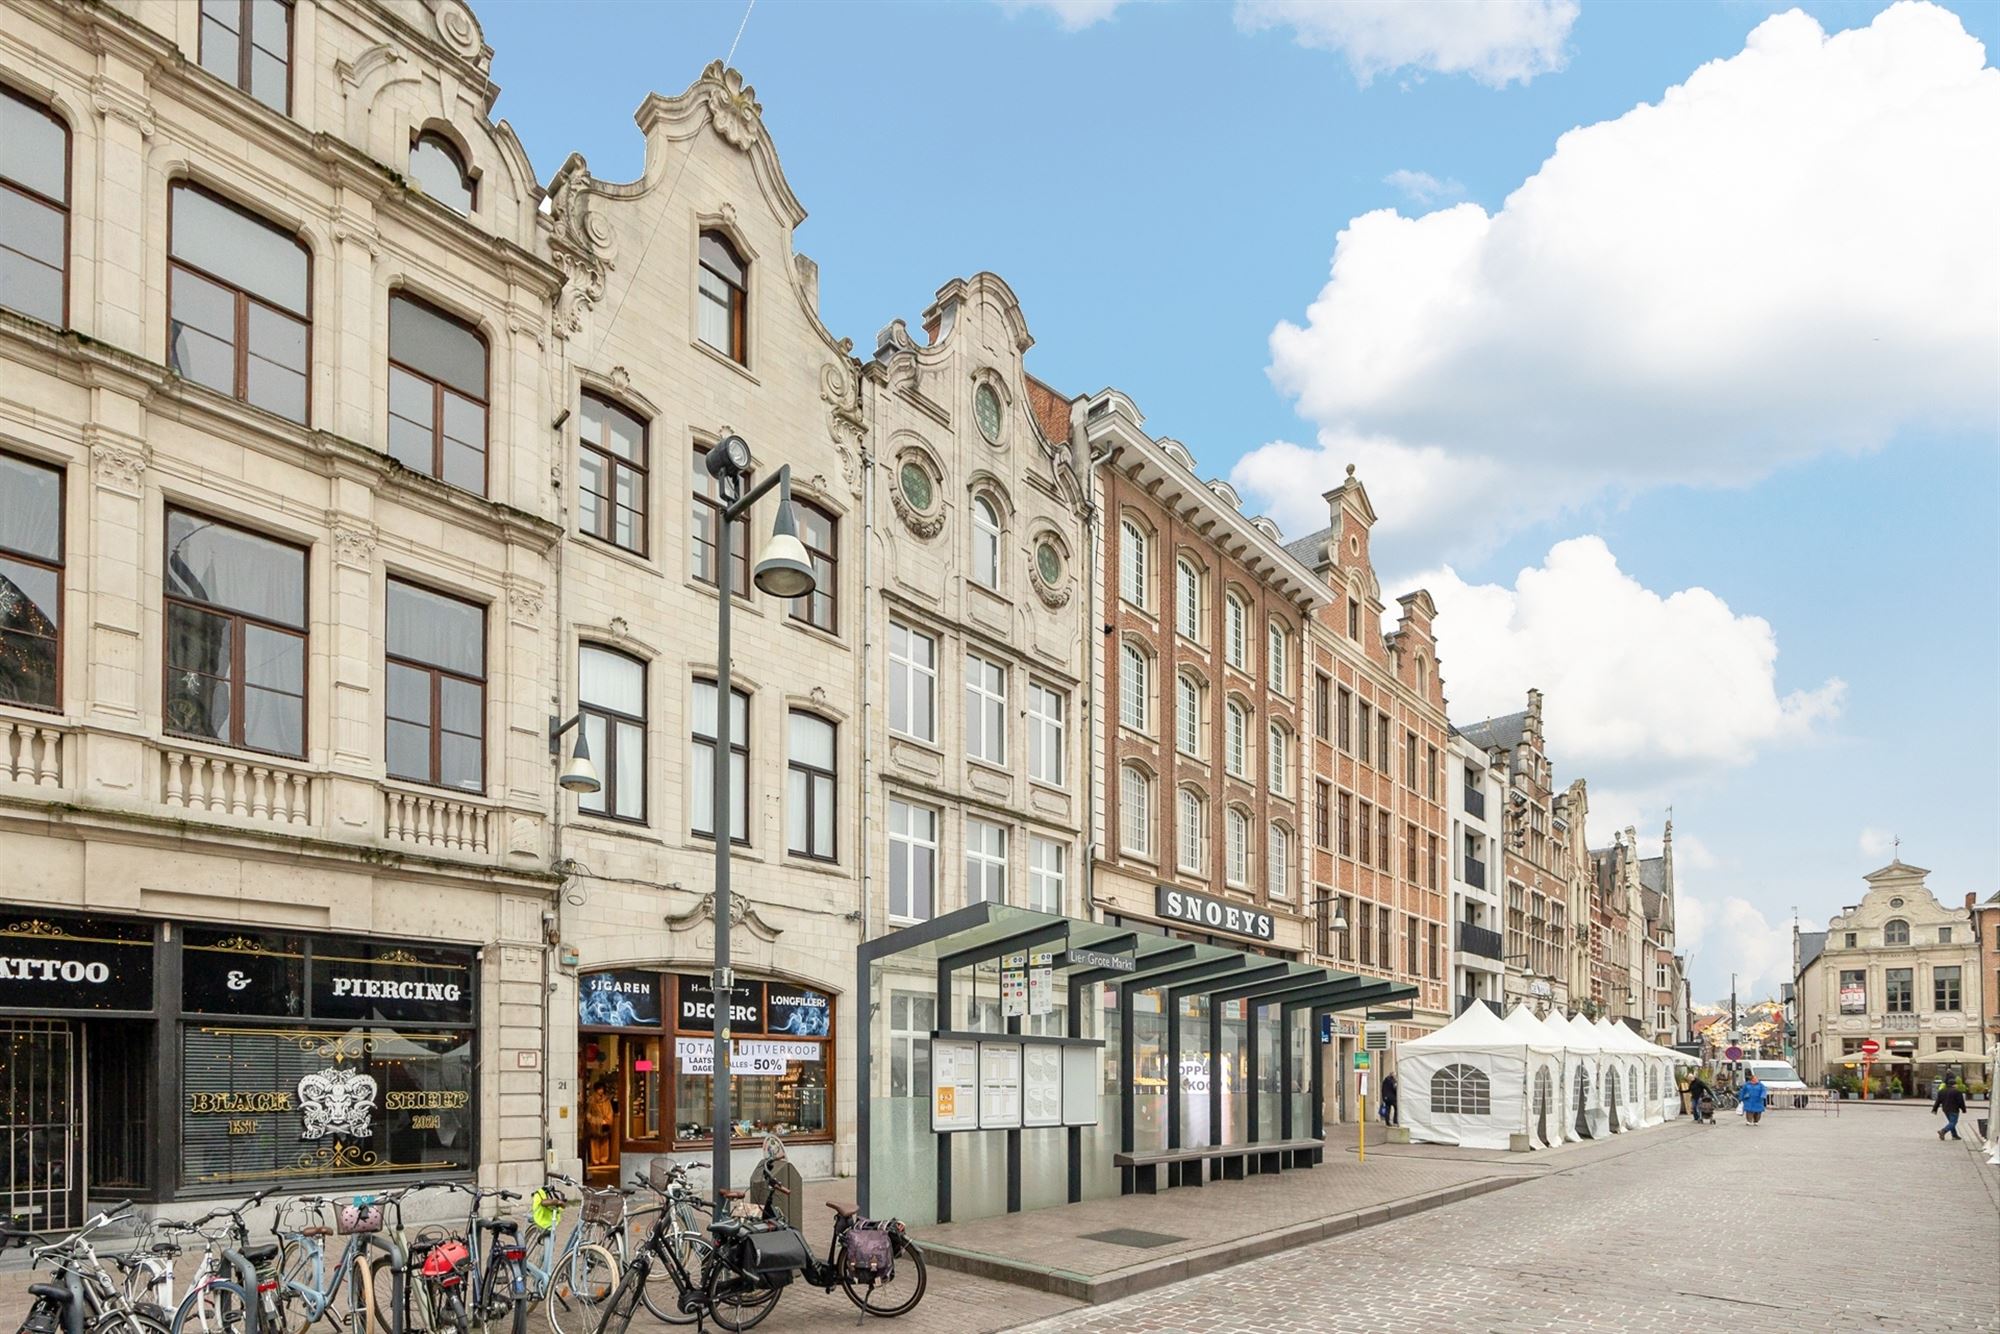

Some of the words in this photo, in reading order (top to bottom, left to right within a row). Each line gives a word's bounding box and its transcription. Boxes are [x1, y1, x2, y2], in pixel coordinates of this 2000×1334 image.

[1167, 891, 1270, 937] SNOEYS
[1070, 951, 1085, 963] Lier
[1087, 953, 1110, 967] Grote
[1111, 956, 1133, 970] Markt
[226, 970, 252, 990] &
[332, 978, 461, 1001] PIERCING
[590, 979, 650, 994] SIGAREN
[770, 995, 826, 1008] LONGFILLERS
[683, 1002, 757, 1021] DECERC
[678, 1042, 714, 1055] TOTA
[740, 1044, 817, 1056] UITVERKOOP
[689, 1057, 714, 1065] LAATS
[692, 1064, 714, 1072] DAGE
[558, 1081, 567, 1090] 21
[191, 1092, 292, 1113] BLACK
[385, 1090, 469, 1110] SHEEP
[228, 1119, 258, 1135] EST
